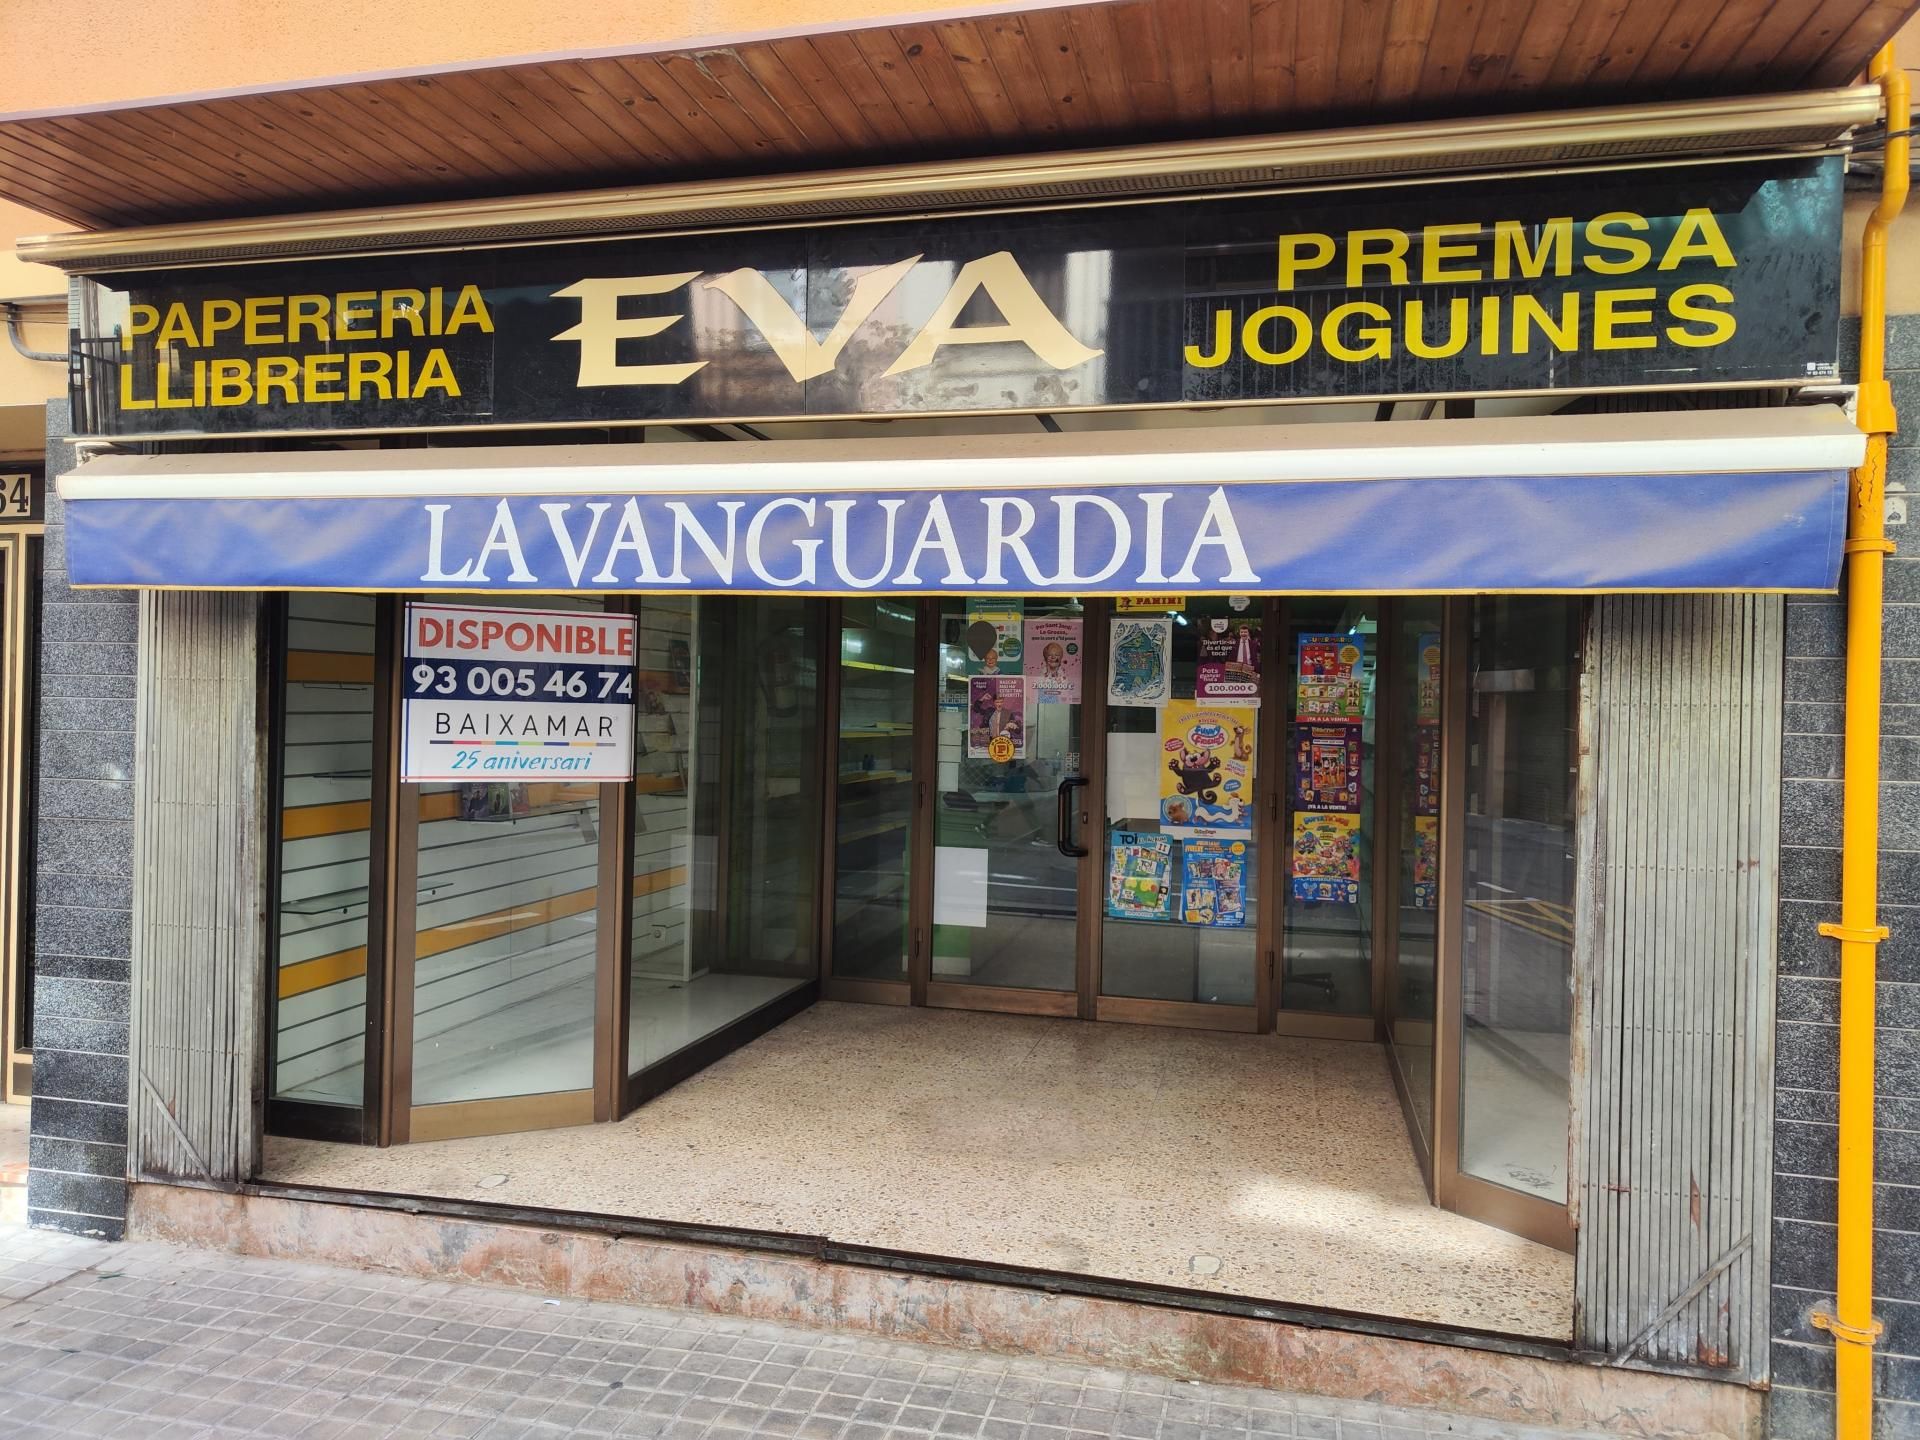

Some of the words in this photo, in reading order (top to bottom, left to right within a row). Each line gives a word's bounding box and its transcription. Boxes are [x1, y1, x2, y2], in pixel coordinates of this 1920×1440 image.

[1277, 207, 1738, 291] PREMSA
[120, 284, 495, 352] PAPERERIA
[549, 250, 1105, 388] EVA
[1183, 283, 1737, 369] JOGUINES
[119, 348, 462, 411] LLIBRERIA
[1136, 597, 1183, 606] PANINI
[418, 617, 633, 657] DISPONIBLE
[412, 664, 458, 694] 93
[466, 666, 537, 698] 005
[543, 670, 588, 699] 46
[597, 672, 633, 700] 74
[1208, 684, 1246, 692] 100.000
[435, 712, 614, 737] BAIXAMAR
[451, 750, 482, 769] 25
[483, 751, 592, 770] aniversari
